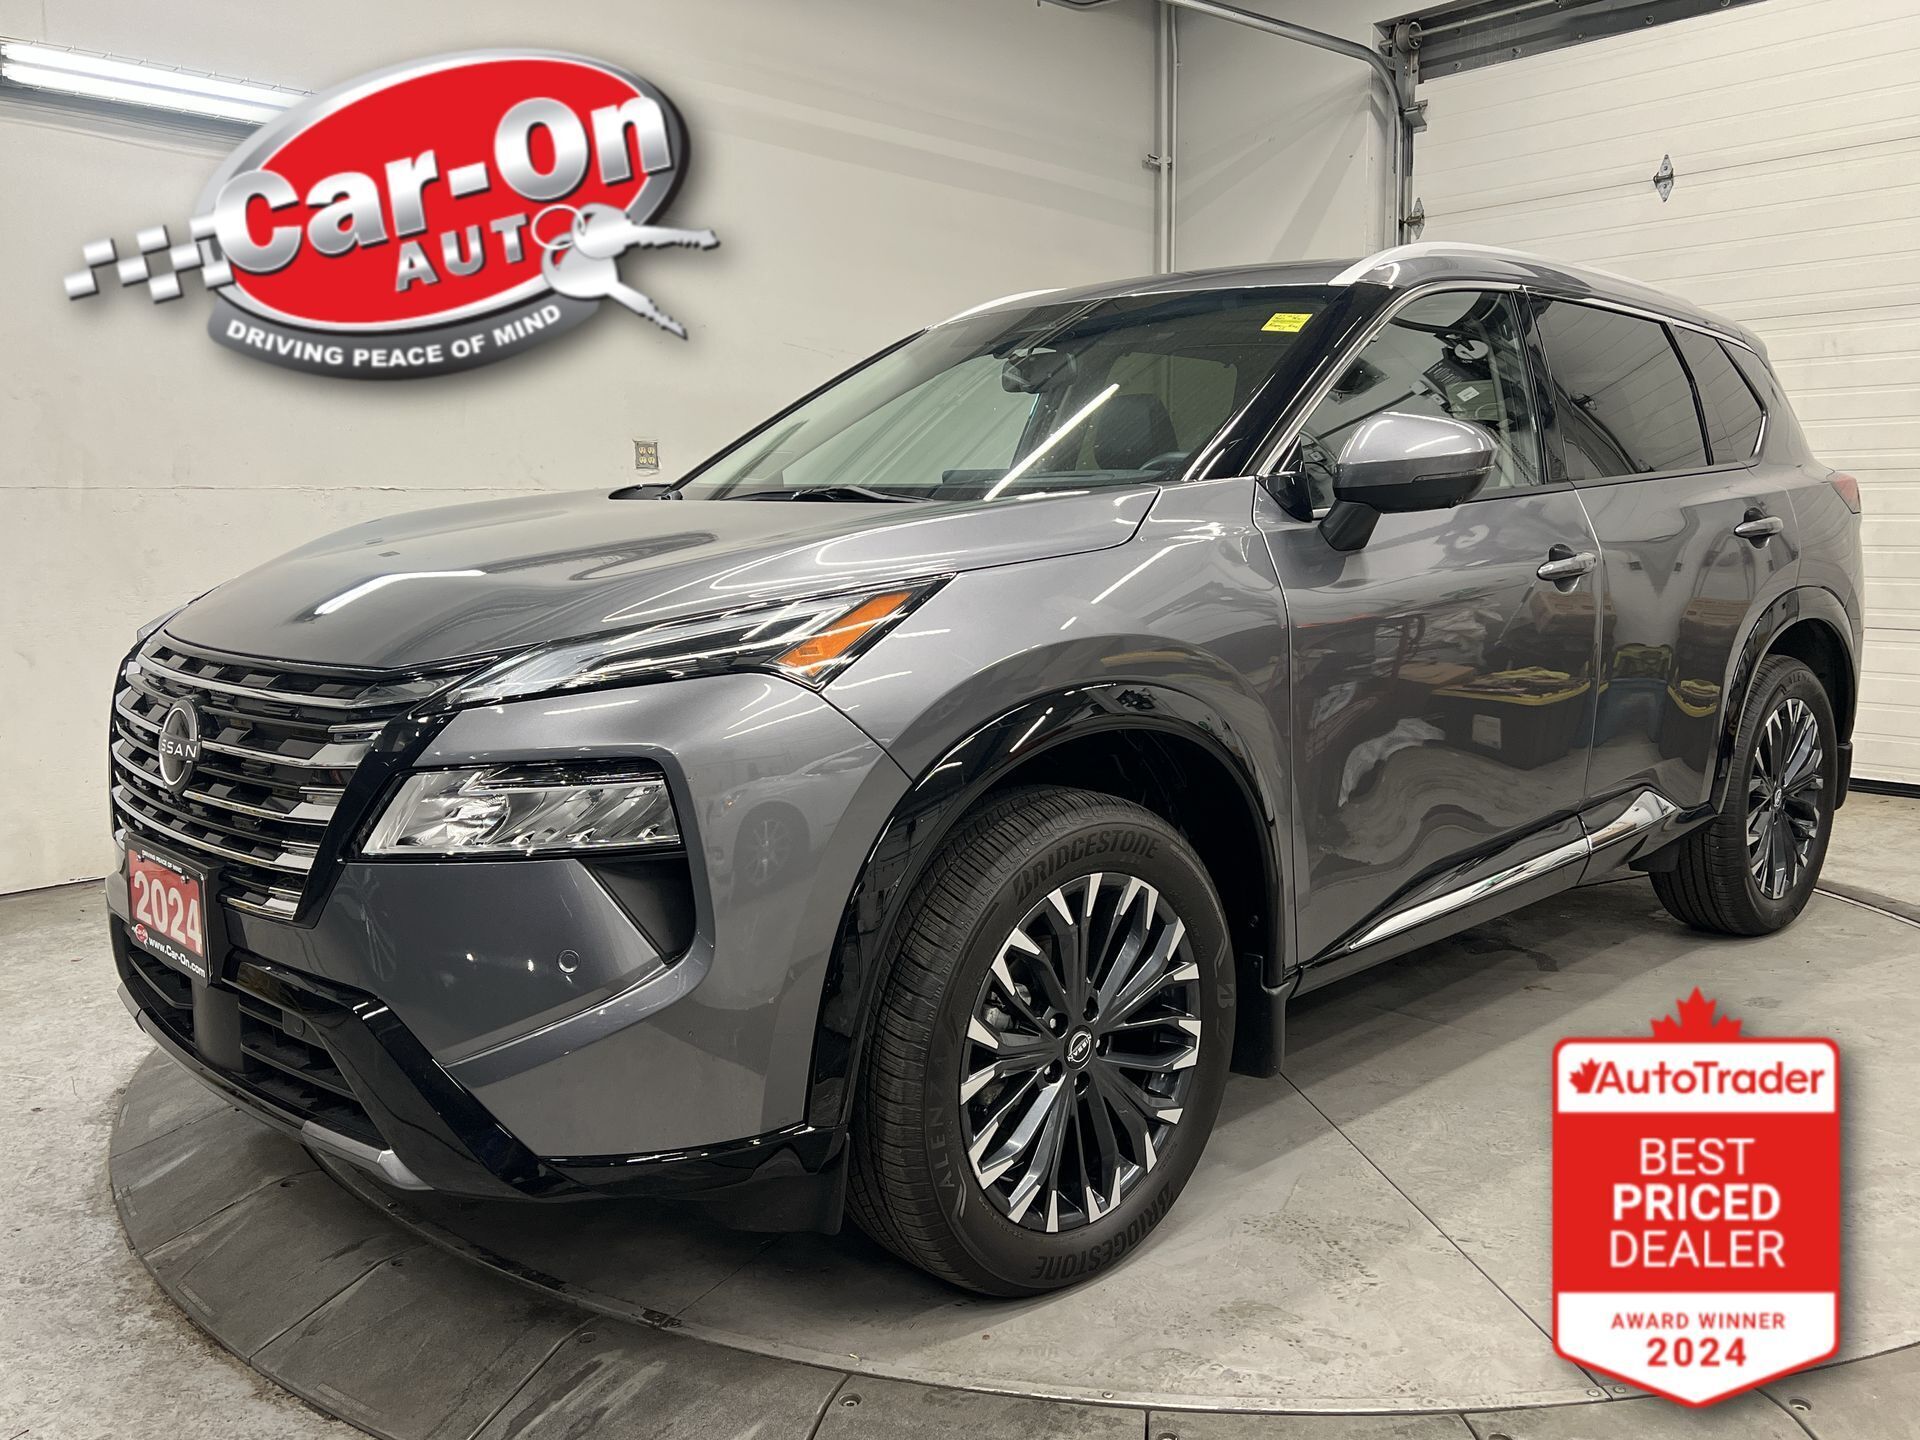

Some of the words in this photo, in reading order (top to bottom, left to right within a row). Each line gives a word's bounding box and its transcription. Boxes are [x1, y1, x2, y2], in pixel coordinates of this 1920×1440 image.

[161, 738, 197, 758] SSAN
[1012, 829, 1161, 905] BRIDGESTONE
[134, 870, 203, 954] 2024
[1030, 1180, 1174, 1281] BRIDGESTONE
